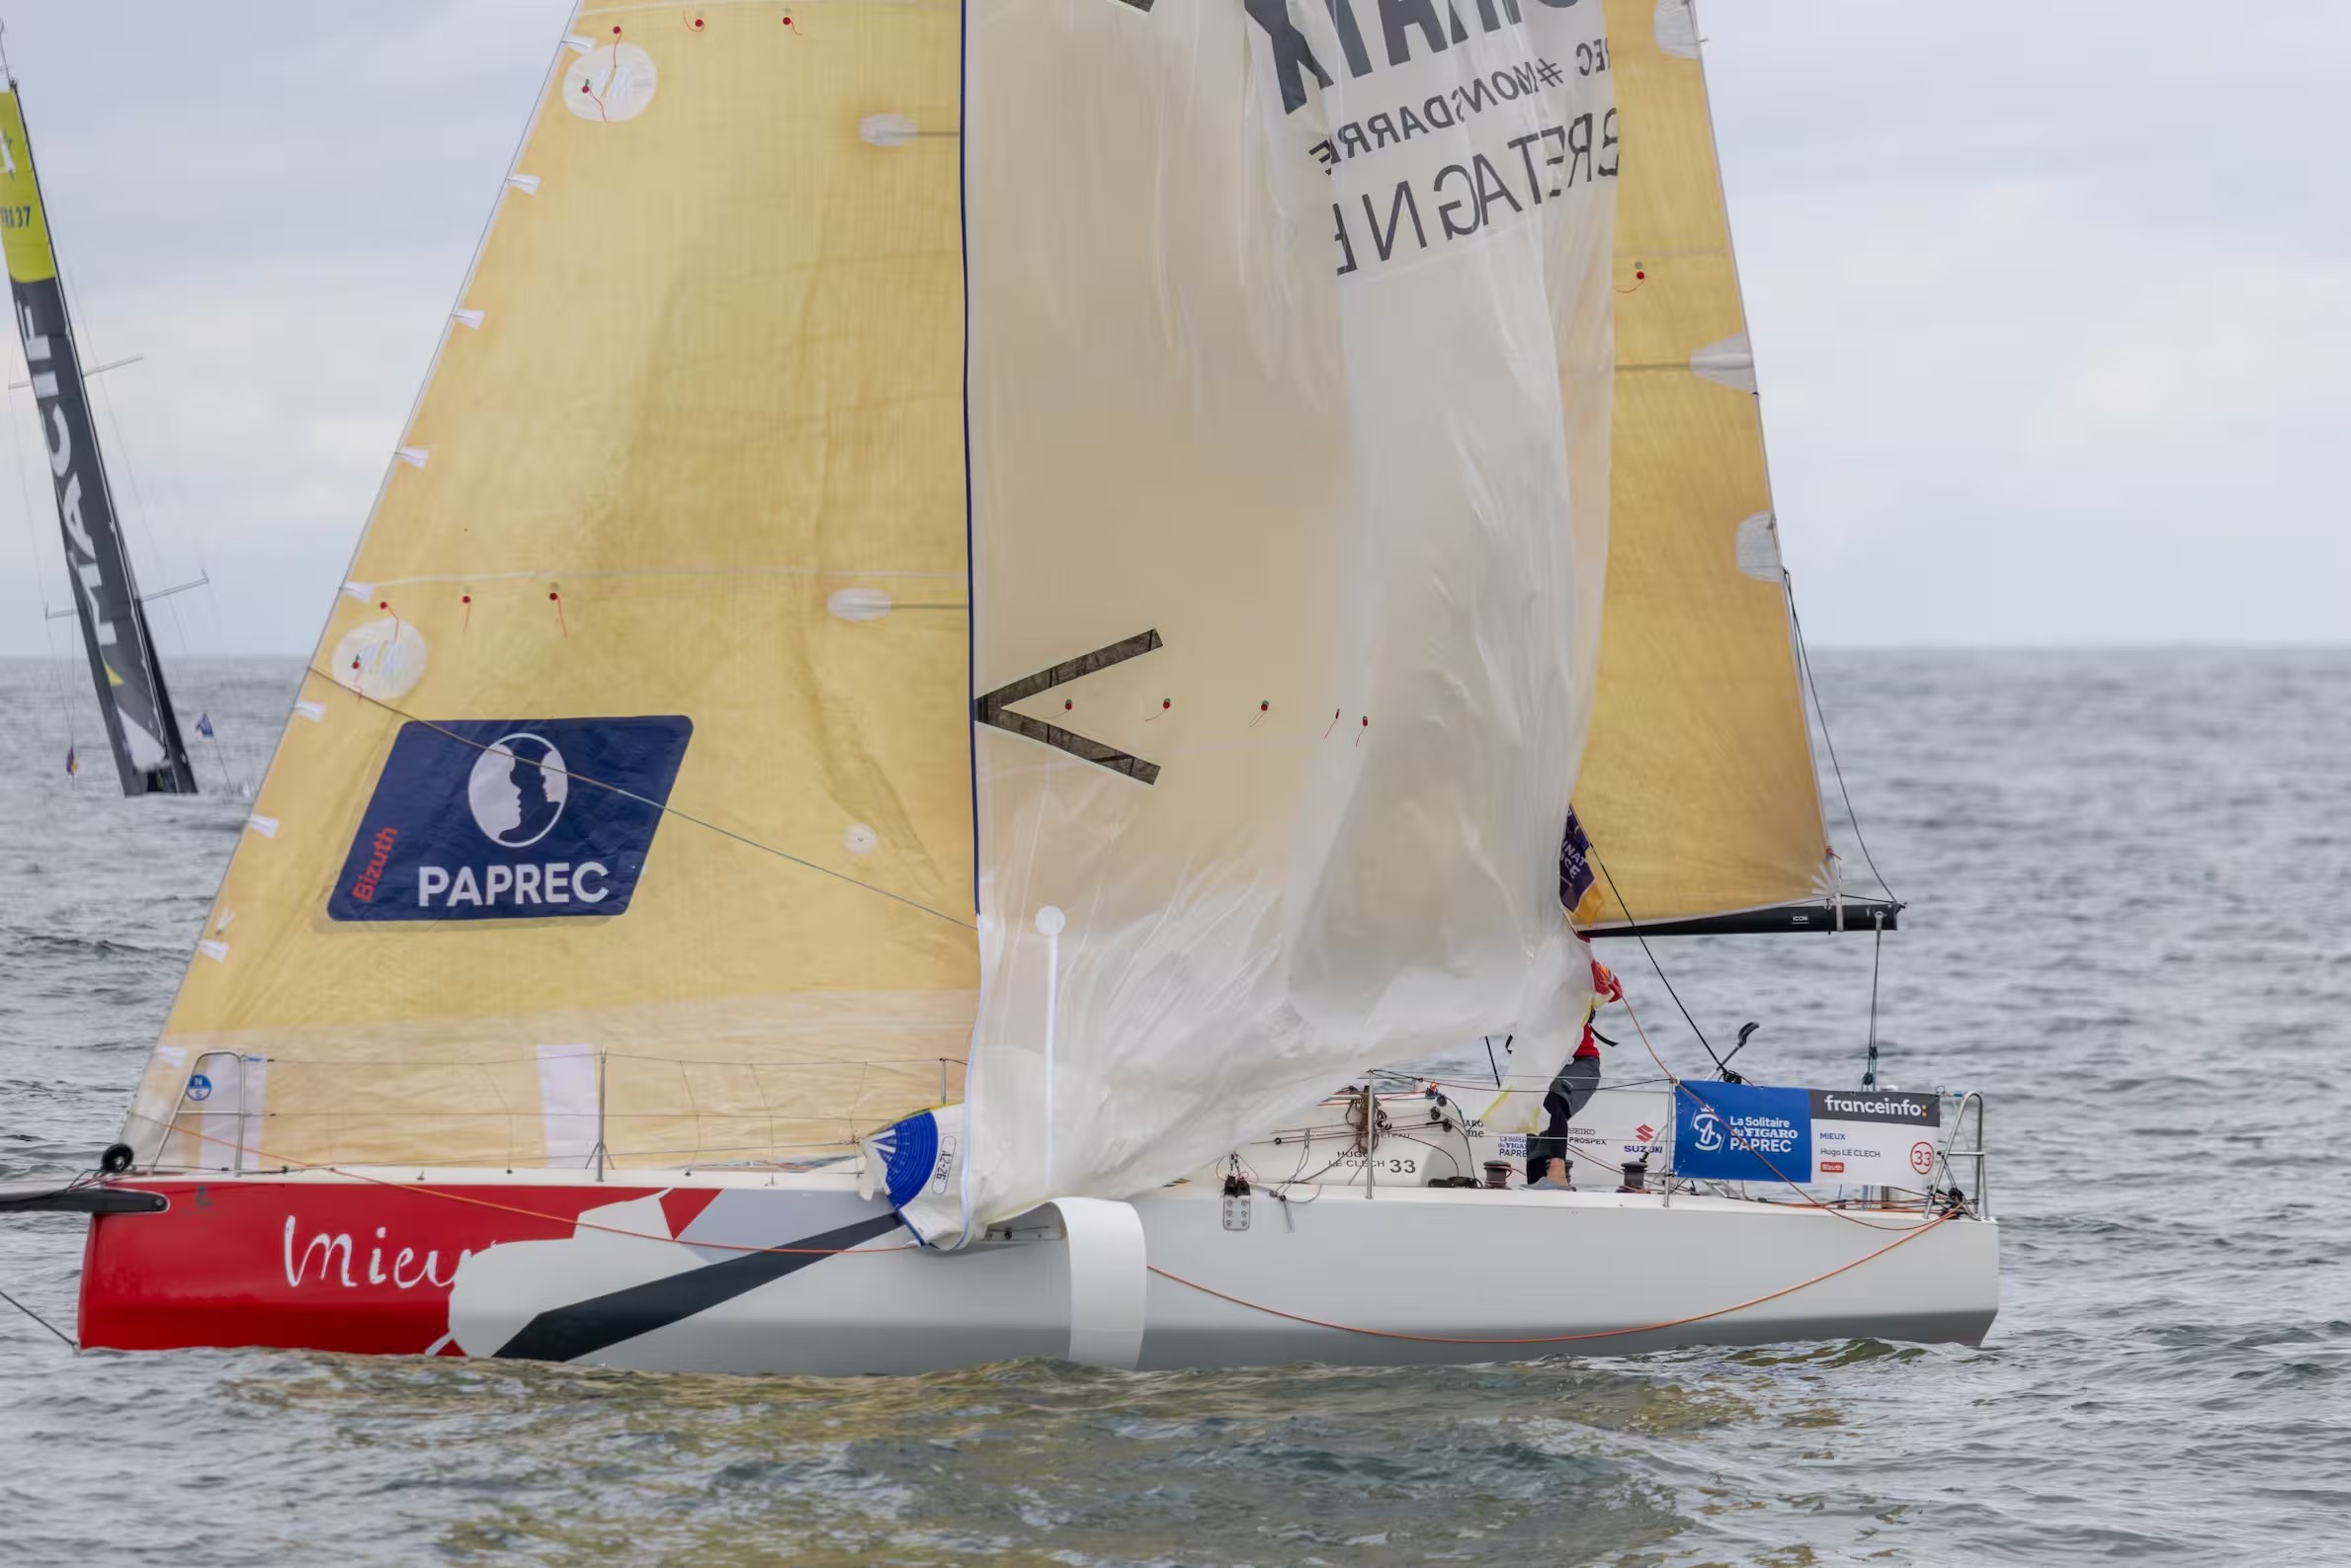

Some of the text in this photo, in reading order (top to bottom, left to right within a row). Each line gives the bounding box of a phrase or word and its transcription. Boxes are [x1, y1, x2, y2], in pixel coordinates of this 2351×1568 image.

[353, 826, 398, 902] Bizuth
[419, 862, 610, 907] PAPREC
[1730, 1115, 1790, 1127] La Solitaire
[1568, 1136, 1607, 1145] PROSPEX
[1730, 1127, 1799, 1139] du FIGARO
[1499, 1148, 1527, 1157] PAPRE
[1730, 1138, 1792, 1153] PAPREC
[1820, 1148, 1841, 1157] Hugo
[1854, 1149, 1881, 1158] CLECH
[1914, 1150, 1933, 1167] 33
[1389, 1159, 1416, 1174] 33
[284, 1215, 472, 1289] Mieu
